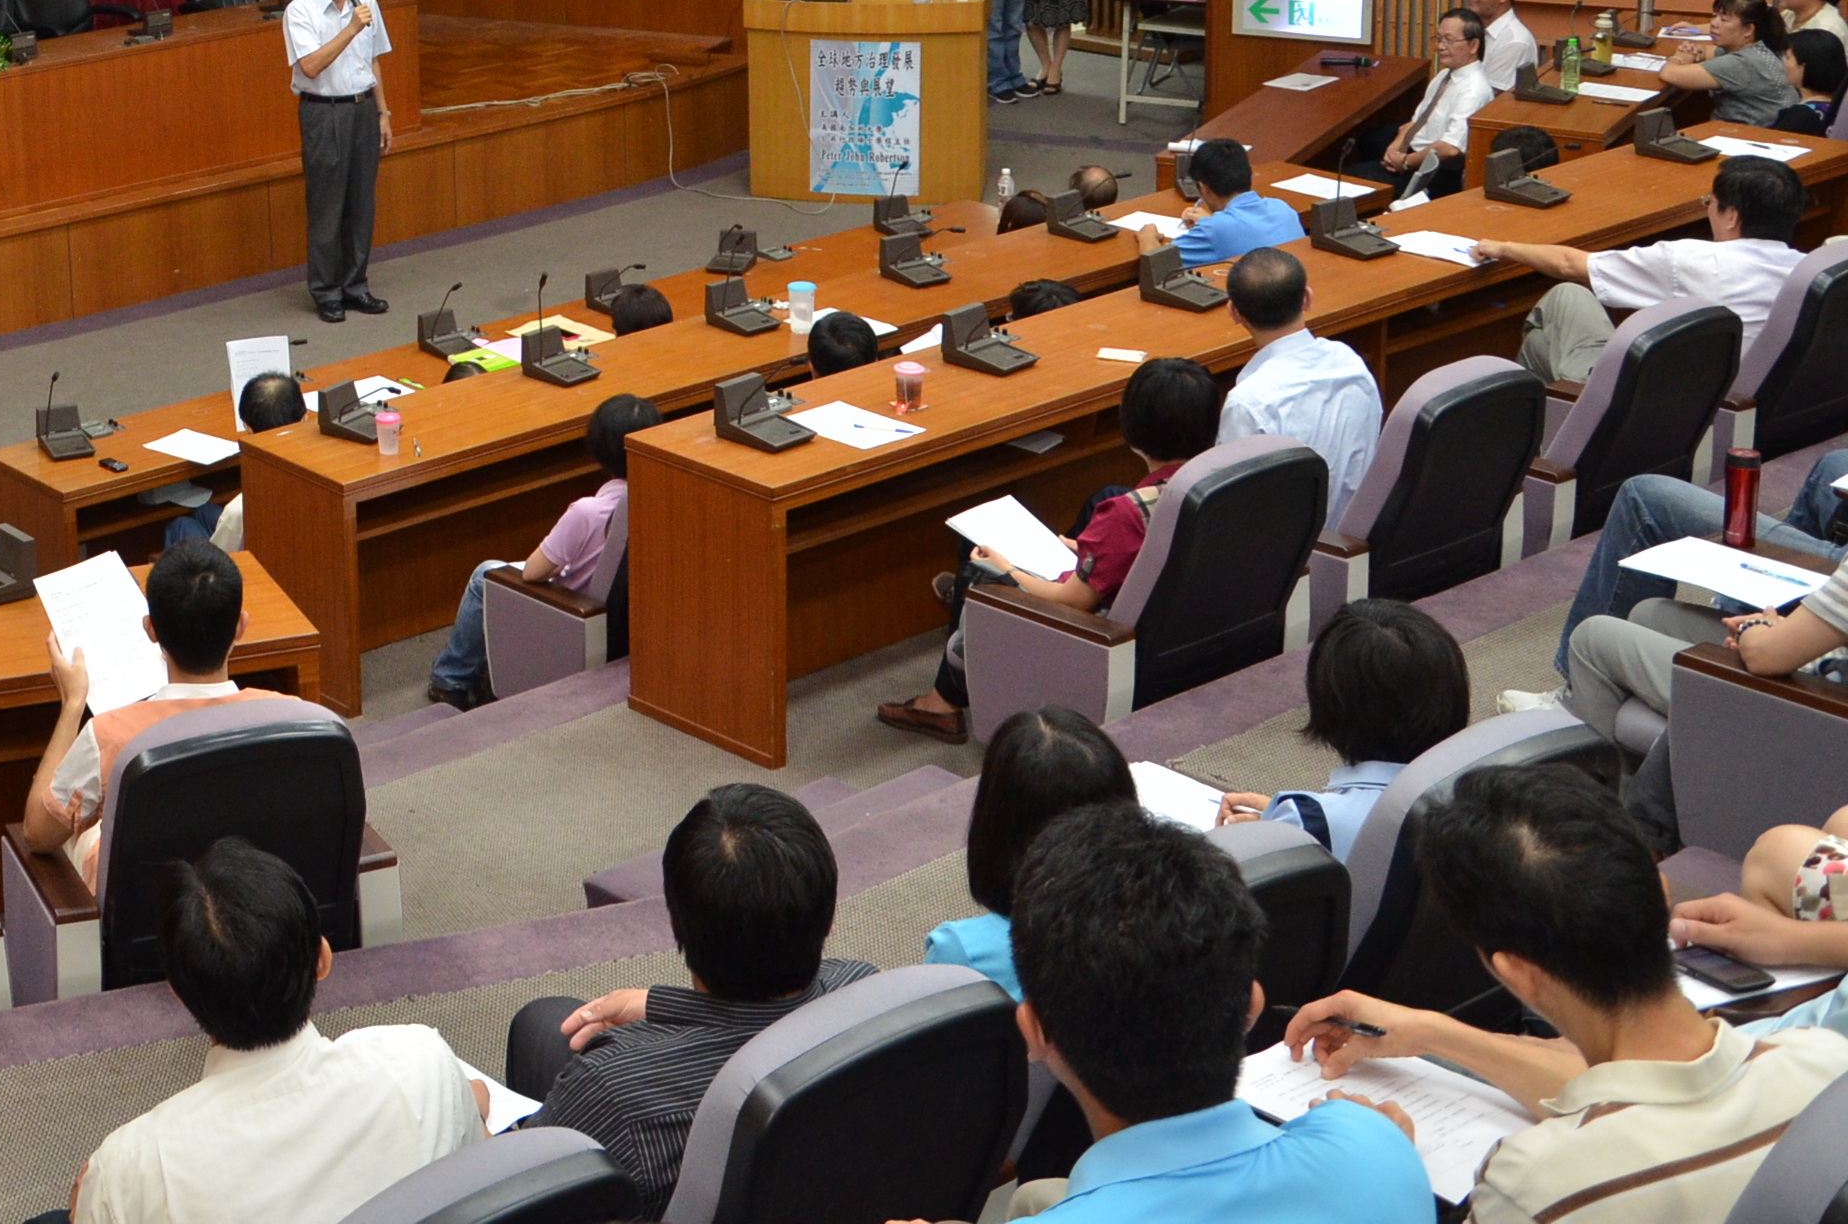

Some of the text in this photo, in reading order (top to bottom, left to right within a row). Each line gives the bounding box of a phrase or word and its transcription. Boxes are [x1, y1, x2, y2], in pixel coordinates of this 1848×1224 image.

[817, 49, 914, 71] 全球地方治理發展
[834, 76, 895, 97] 趨勢與展望
[821, 149, 910, 164] Peter John Robertson
